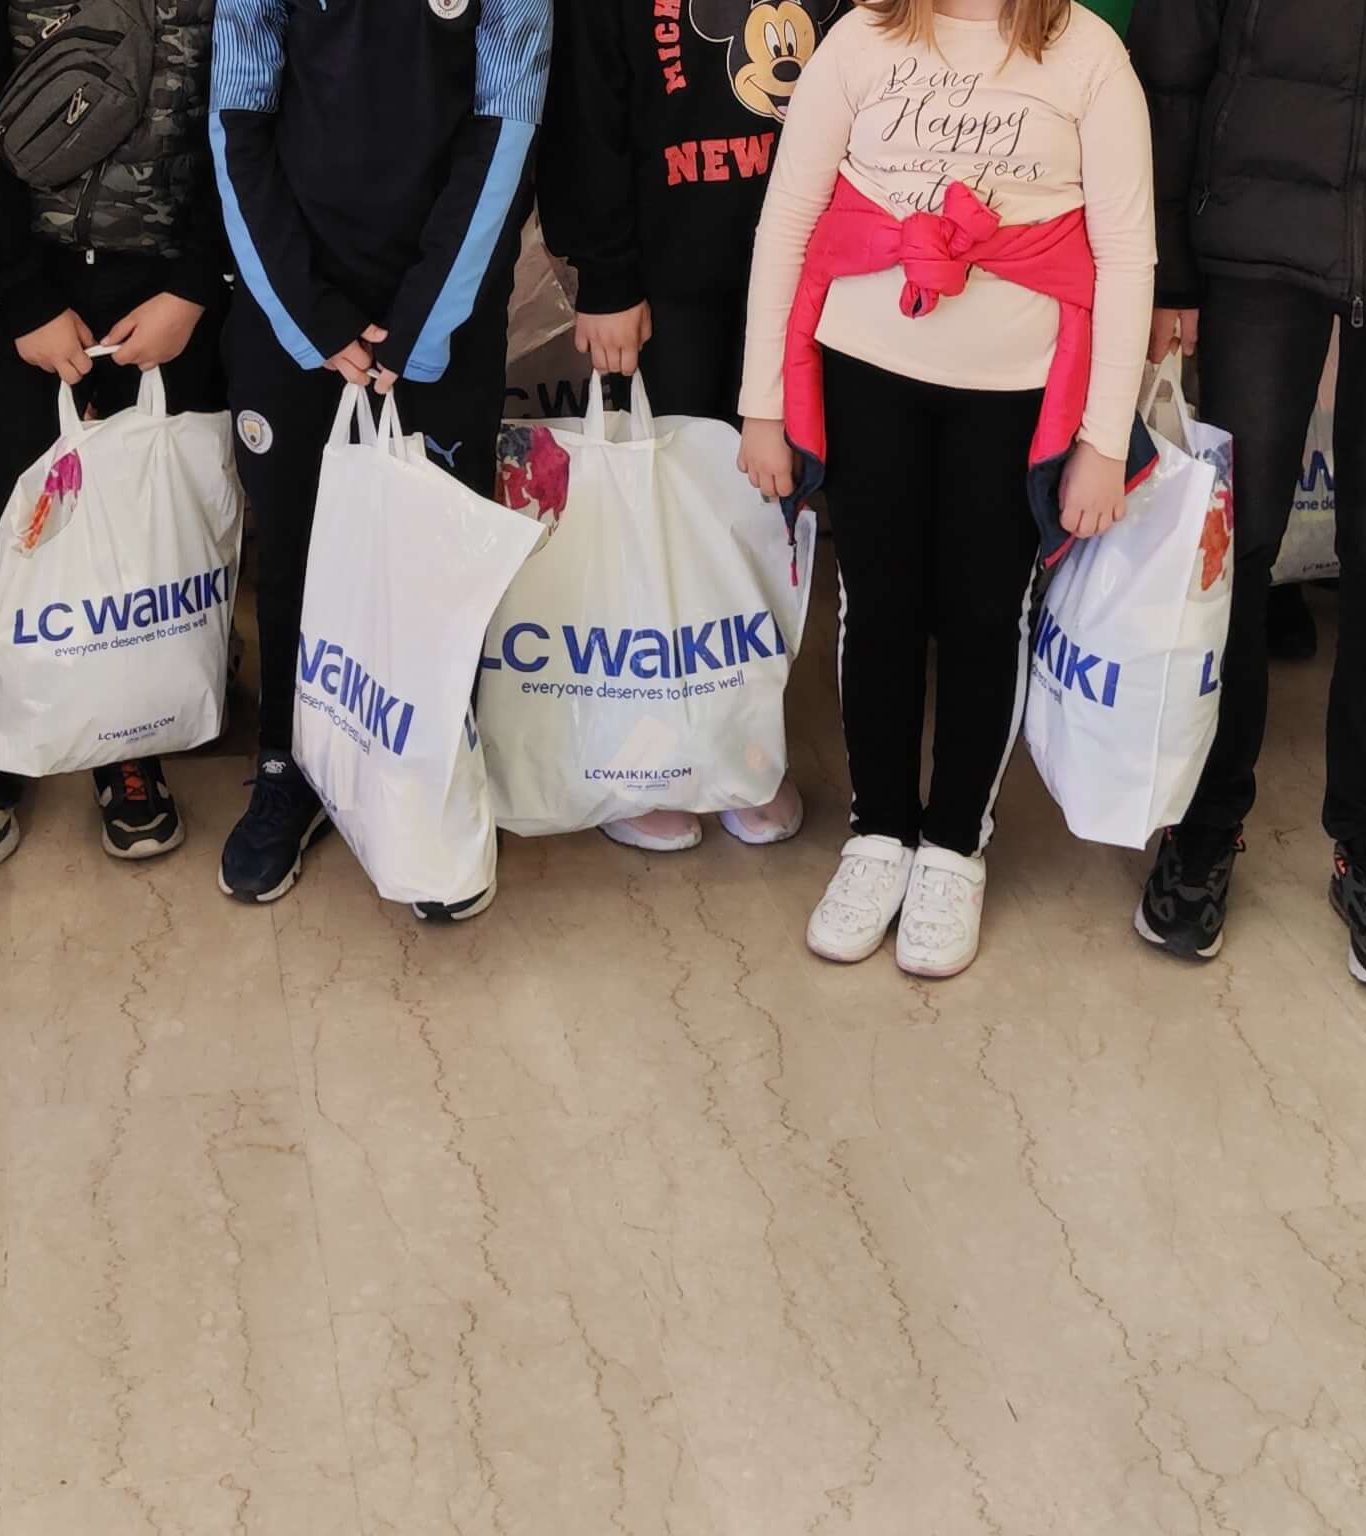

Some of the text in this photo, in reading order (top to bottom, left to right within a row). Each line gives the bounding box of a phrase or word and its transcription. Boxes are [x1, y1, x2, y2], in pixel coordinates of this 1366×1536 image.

[881, 90, 1029, 157] Happy
[664, 132, 775, 186] NEW
[874, 159, 1044, 191] ver goes
[889, 175, 948, 212] out
[13, 602, 74, 645] LC
[54, 640, 108, 657] everyone
[110, 632, 156, 650] deserves
[157, 628, 166, 639] to
[167, 621, 191, 636] dress
[521, 670, 745, 706] everyone deserves to dress well
[1199, 650, 1221, 698] L
[98, 716, 176, 742] LCWAIKIKI.COM
[585, 767, 692, 781] LCWAIKIKI.COM
